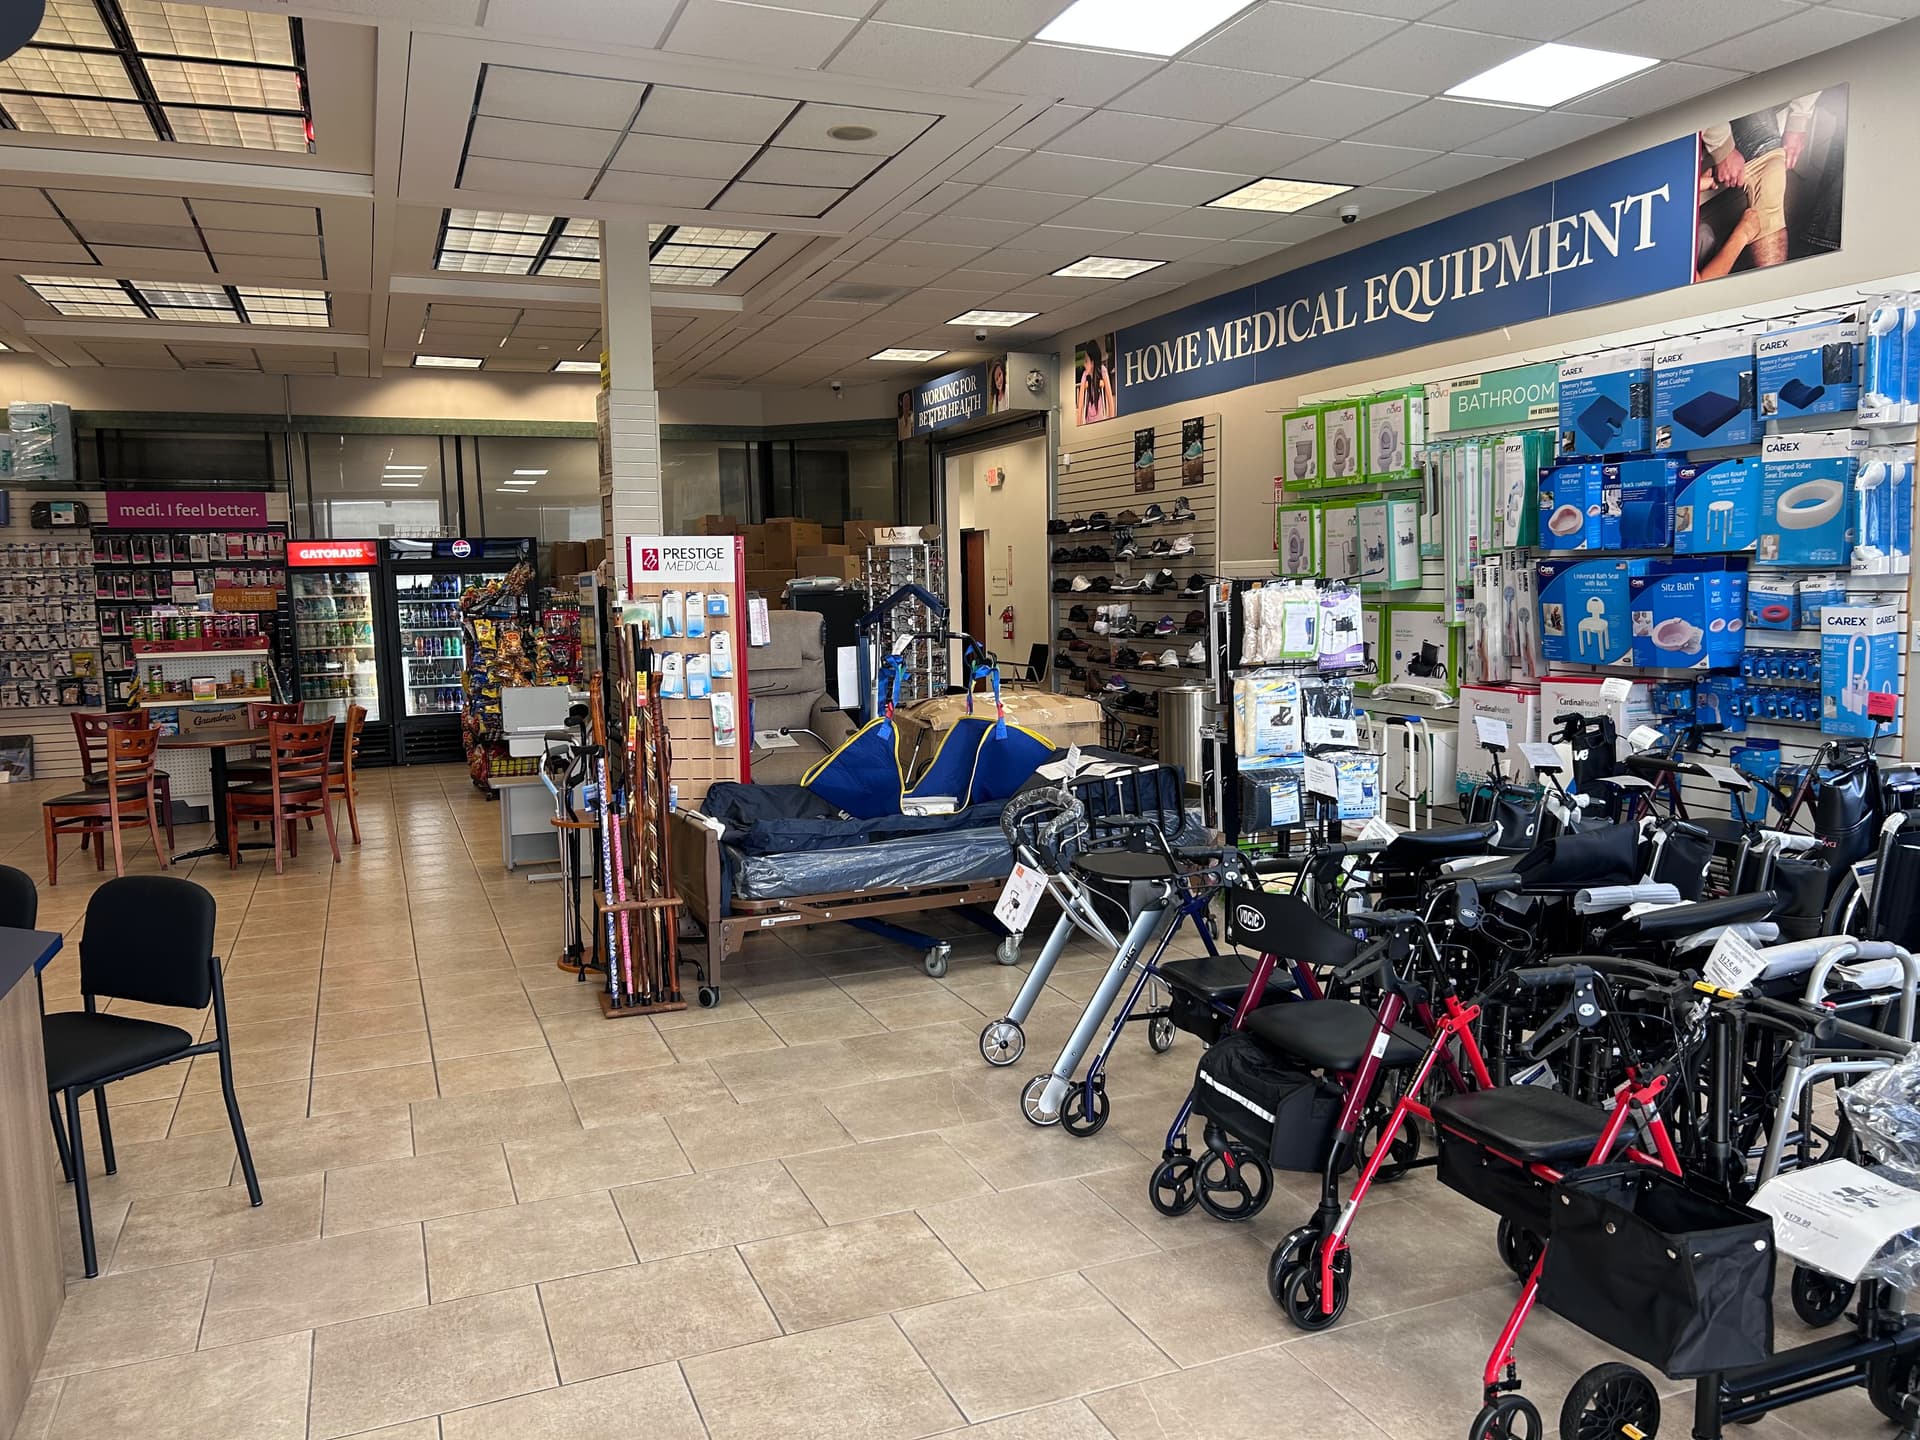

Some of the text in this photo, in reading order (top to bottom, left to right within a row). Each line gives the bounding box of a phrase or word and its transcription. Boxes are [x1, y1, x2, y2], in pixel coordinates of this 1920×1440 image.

[1124, 183, 1671, 387] HOME MEDICAL EQUIPMENT
[1759, 339, 1789, 351] CAREX
[1657, 353, 1683, 364] CAREX
[1561, 366, 1583, 377] CAREX
[1657, 371, 1678, 379] Memory
[1561, 382, 1579, 390] Memory
[1657, 376, 1691, 387] Seat Cushion
[921, 375, 977, 408] WORKING FOR
[1430, 387, 1448, 399] nova
[1578, 386, 1597, 394] Cushion
[1458, 382, 1556, 413] BATHROOM
[918, 393, 981, 428] BETTER HEALTH
[1859, 412, 1880, 420] CAREX
[1505, 444, 1521, 453] PCP
[1766, 442, 1800, 453] CAREX
[1765, 464, 1795, 473] Elongated
[1707, 469, 1748, 480] Compact Round
[1634, 480, 1652, 488] cushion
[120, 503, 259, 517] medi. I feel better.
[880, 528, 896, 538] LA
[300, 548, 363, 559] GATORADE
[663, 547, 725, 560] PRESTIGE
[664, 560, 721, 571] MEDICAL
[1661, 582, 1695, 592] Sitz Bath
[1761, 584, 1778, 592] CAREX
[216, 594, 273, 603] PAIN RELIEF
[1827, 616, 1867, 627] CAREX
[1876, 615, 1897, 625] CAREX
[1824, 636, 1849, 645] Bathtub
[1475, 703, 1511, 714] CardinalHealth
[1560, 698, 1600, 708] CardinalHealth
[193, 712, 236, 727] Grandma's
[1719, 953, 1743, 976] $125.00
[1783, 1211, 1812, 1228] $179.99
